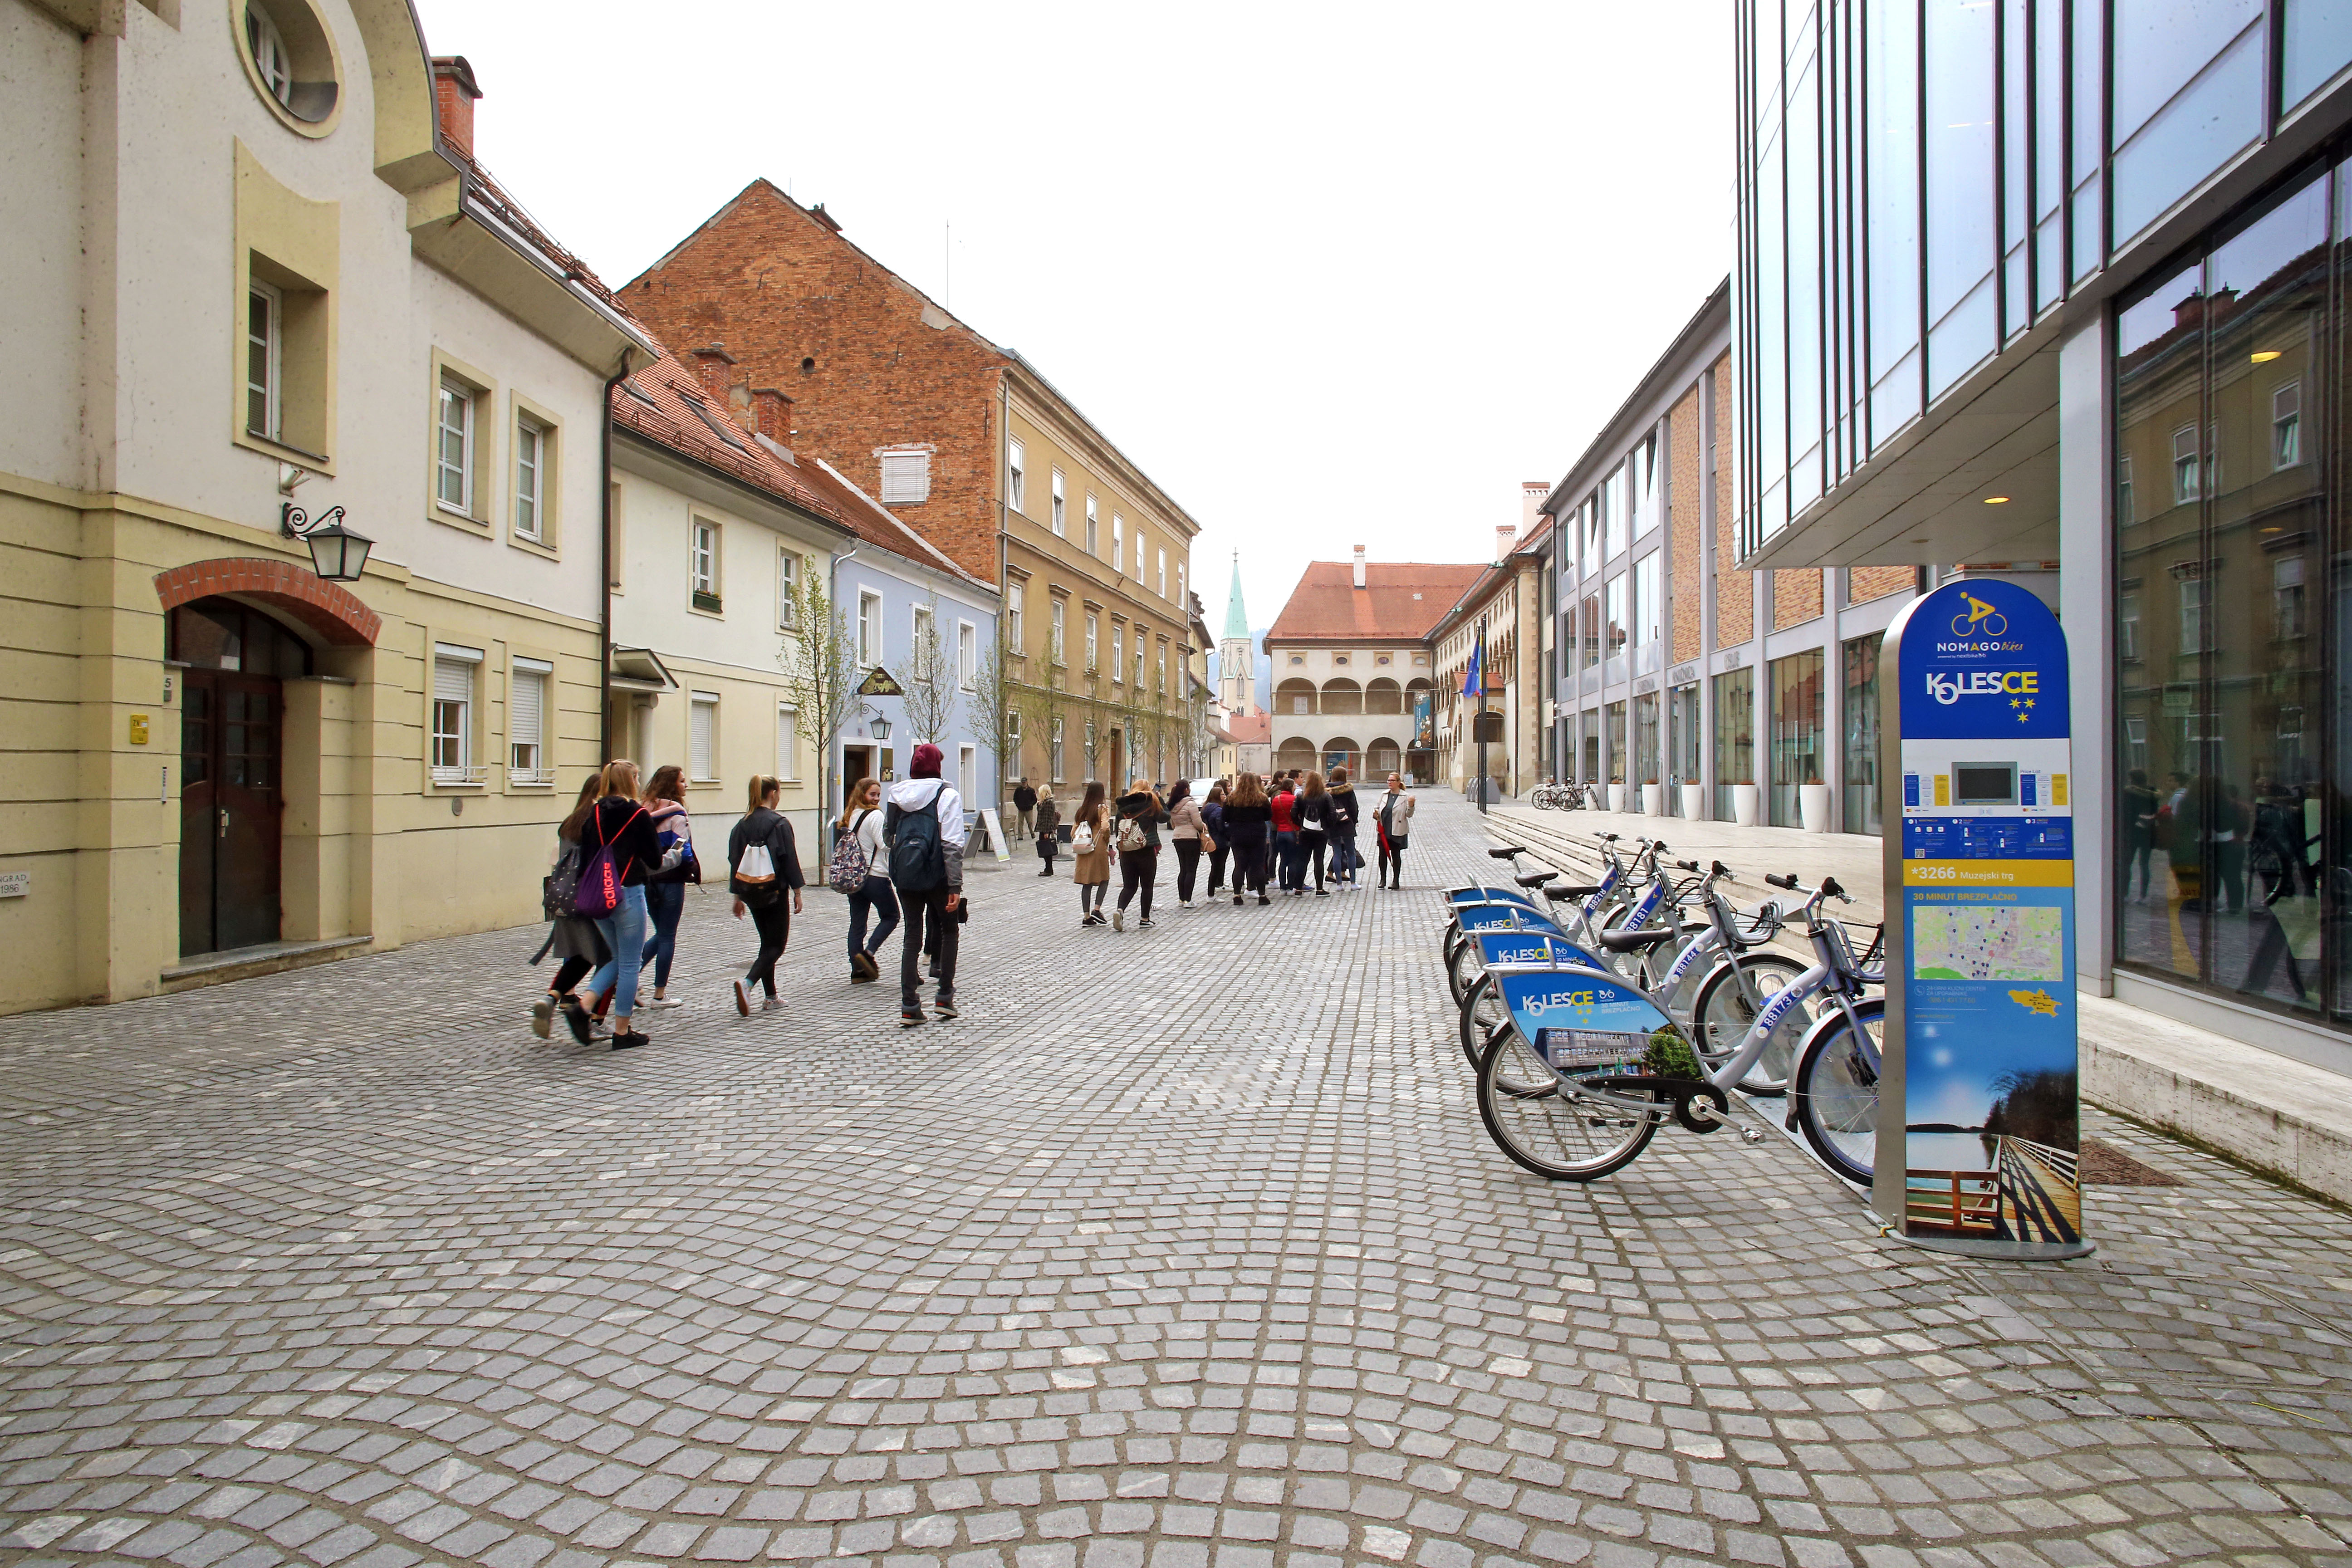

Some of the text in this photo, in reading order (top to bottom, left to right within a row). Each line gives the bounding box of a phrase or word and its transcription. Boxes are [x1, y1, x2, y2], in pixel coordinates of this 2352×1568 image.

[1937, 642, 2000, 652] NOMAGO
[165, 678, 172, 687] 5
[1926, 671, 2039, 705] KOLESCE
[1960, 871, 1999, 881] Muzejski
[2001, 872, 2014, 881] trg
[0, 884, 19, 893] 1986
[603, 862, 616, 909] adidas
[1958, 892, 2017, 901] BREZPLAČNO
[1474, 919, 1514, 930] KLESC
[1676, 951, 1697, 975] 88144
[1522, 990, 1594, 1017] KOLESCE
[1764, 996, 1792, 1027] 88173
